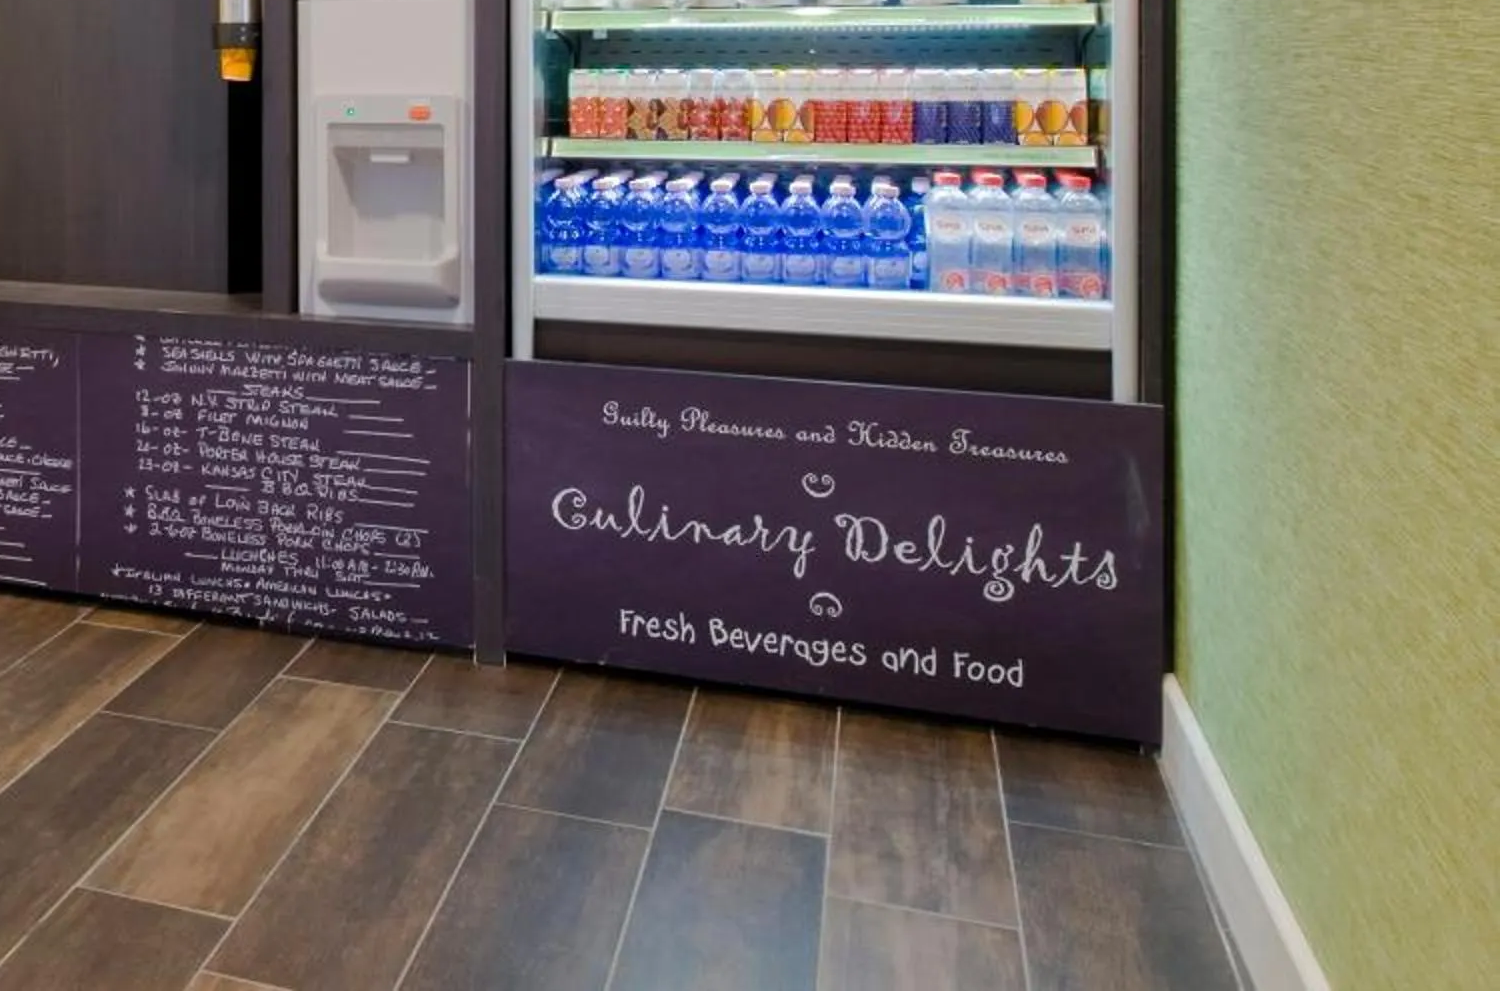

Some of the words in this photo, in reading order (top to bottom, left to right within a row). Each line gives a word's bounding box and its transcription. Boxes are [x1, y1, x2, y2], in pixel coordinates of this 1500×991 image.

[602, 400, 670, 437] Guilty
[680, 406, 786, 440] Pleasures
[796, 424, 837, 445] and
[847, 420, 938, 453] Hidden
[948, 428, 1069, 464] Treasures
[552, 484, 815, 578] Culinary
[834, 512, 1118, 602] Delights
[619, 608, 696, 647] Fresh
[708, 616, 867, 667] Beverages
[882, 647, 937, 677] and
[952, 651, 1024, 689] Food
